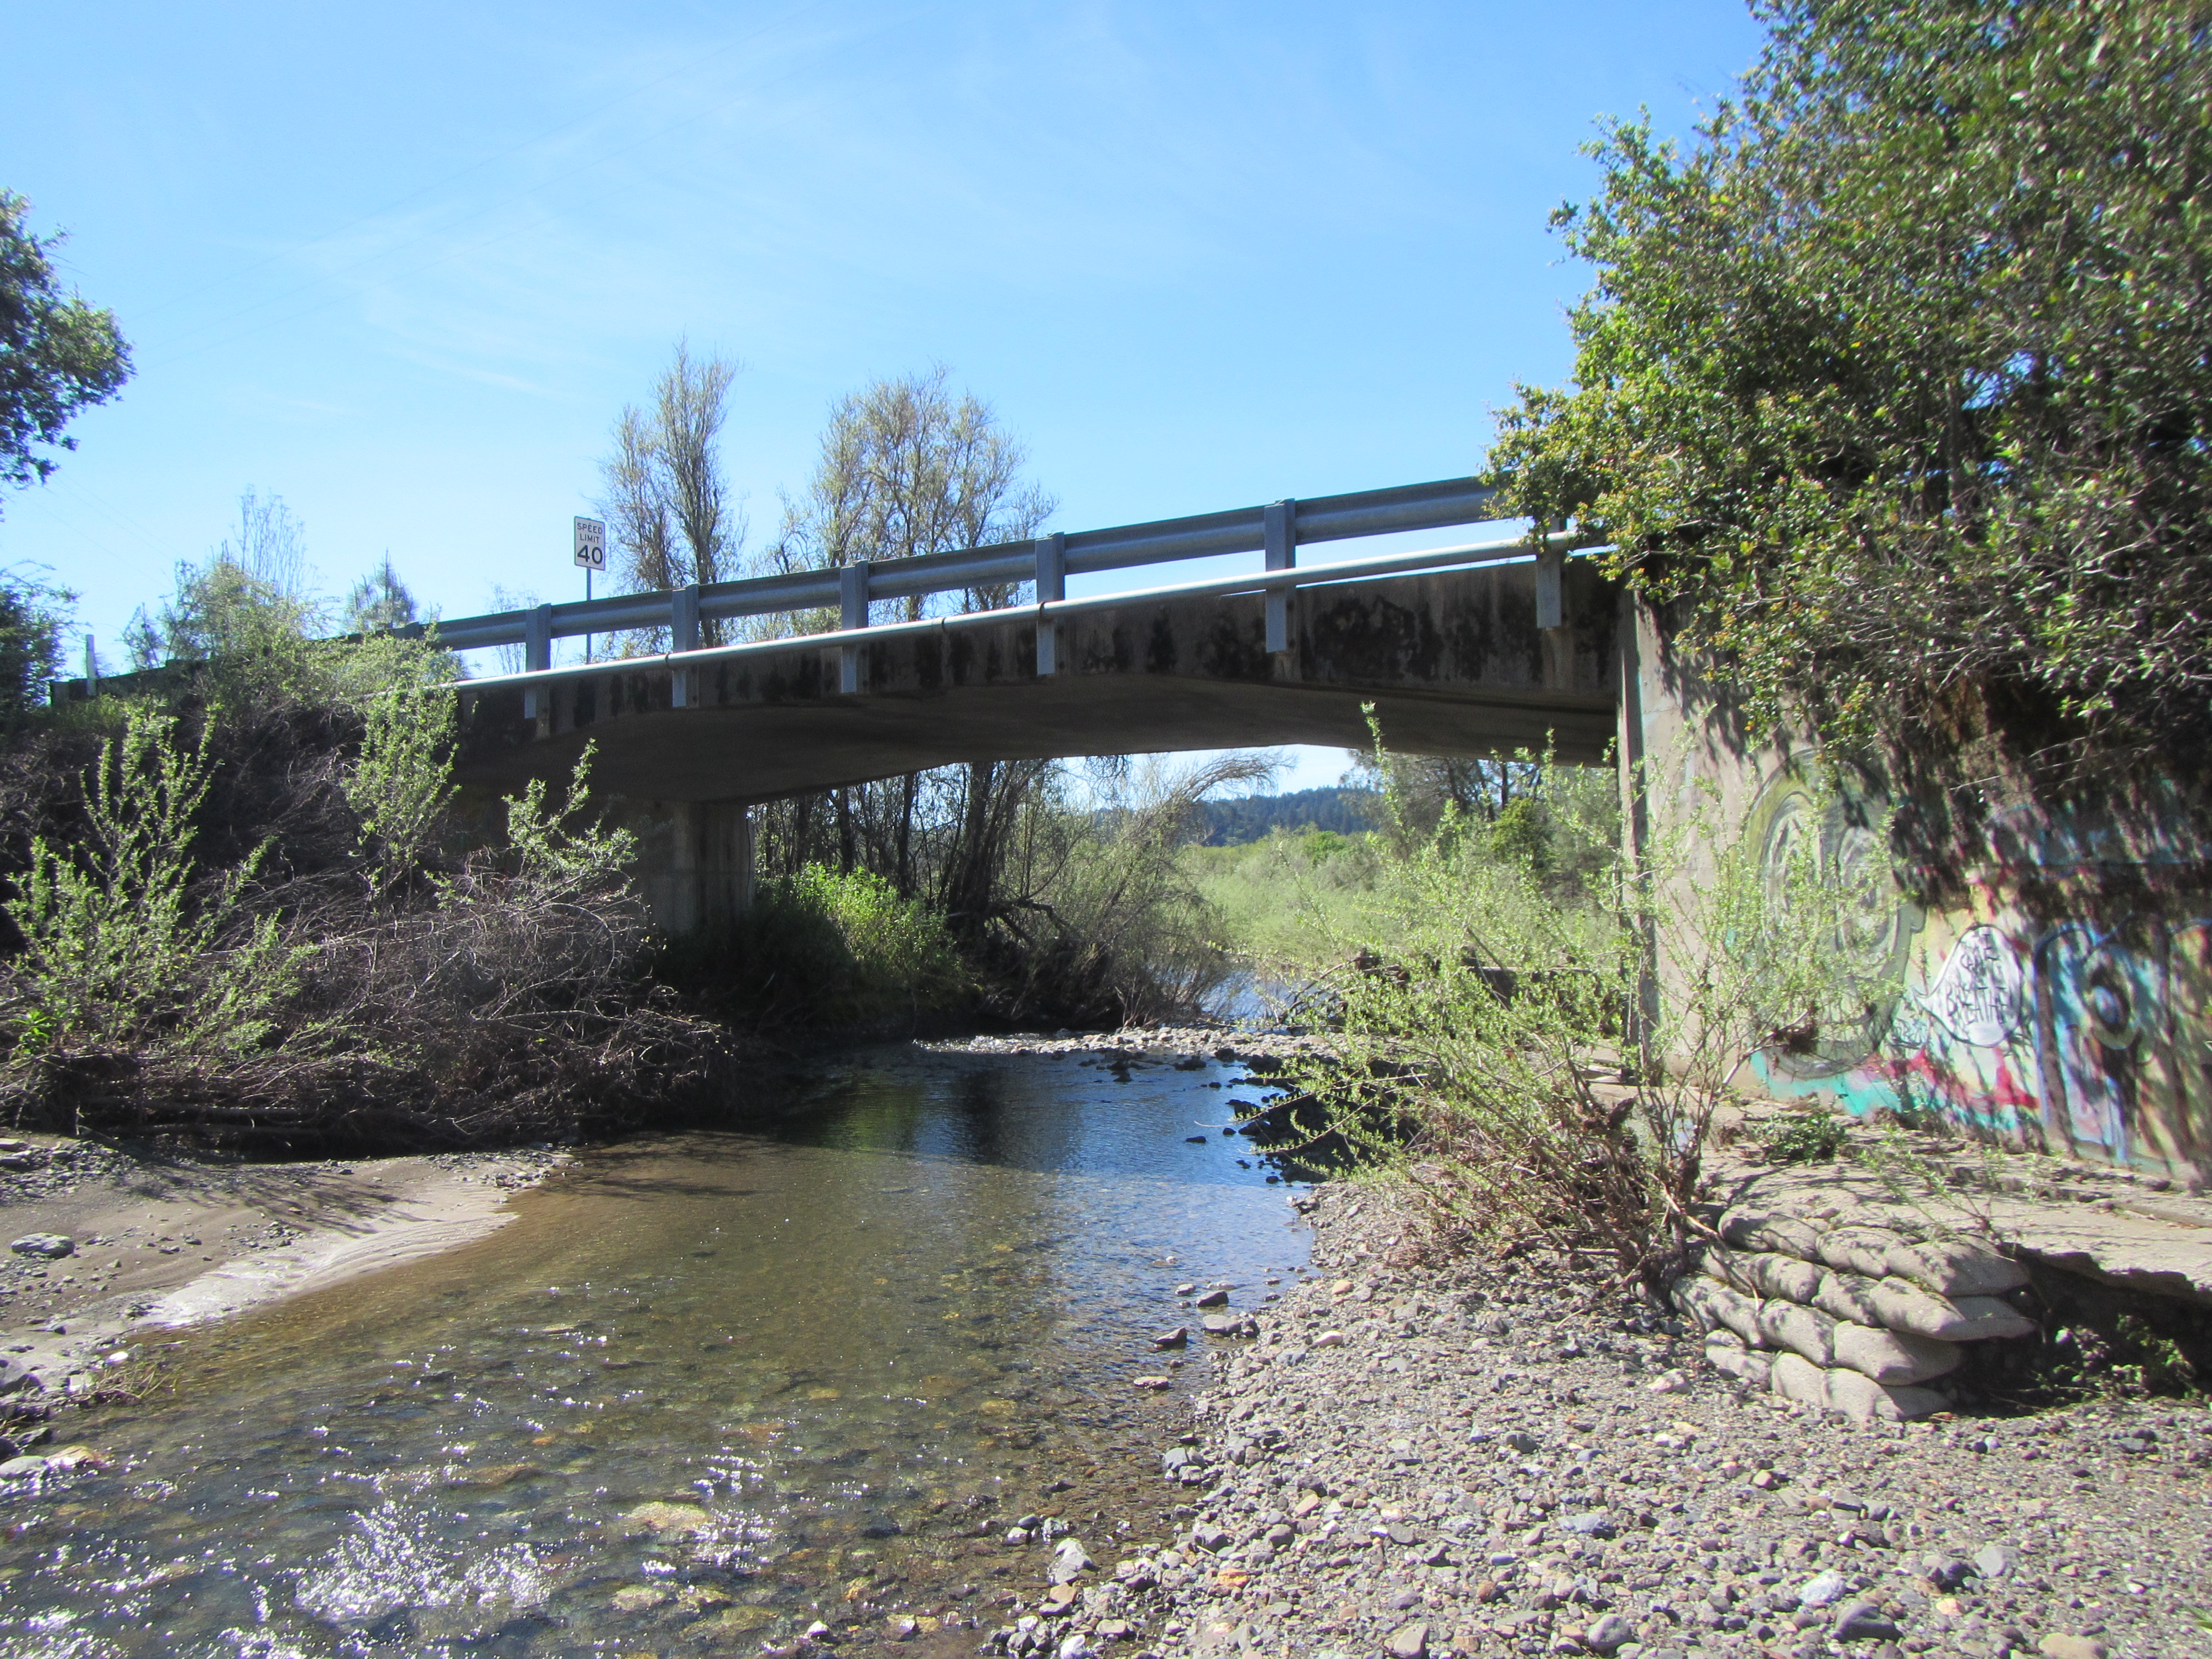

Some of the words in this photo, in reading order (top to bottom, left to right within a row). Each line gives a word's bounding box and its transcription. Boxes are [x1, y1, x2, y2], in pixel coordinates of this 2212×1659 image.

[577, 522, 603, 535] SPEED
[579, 533, 600, 545] LIMIT
[577, 545, 603, 565] 40
